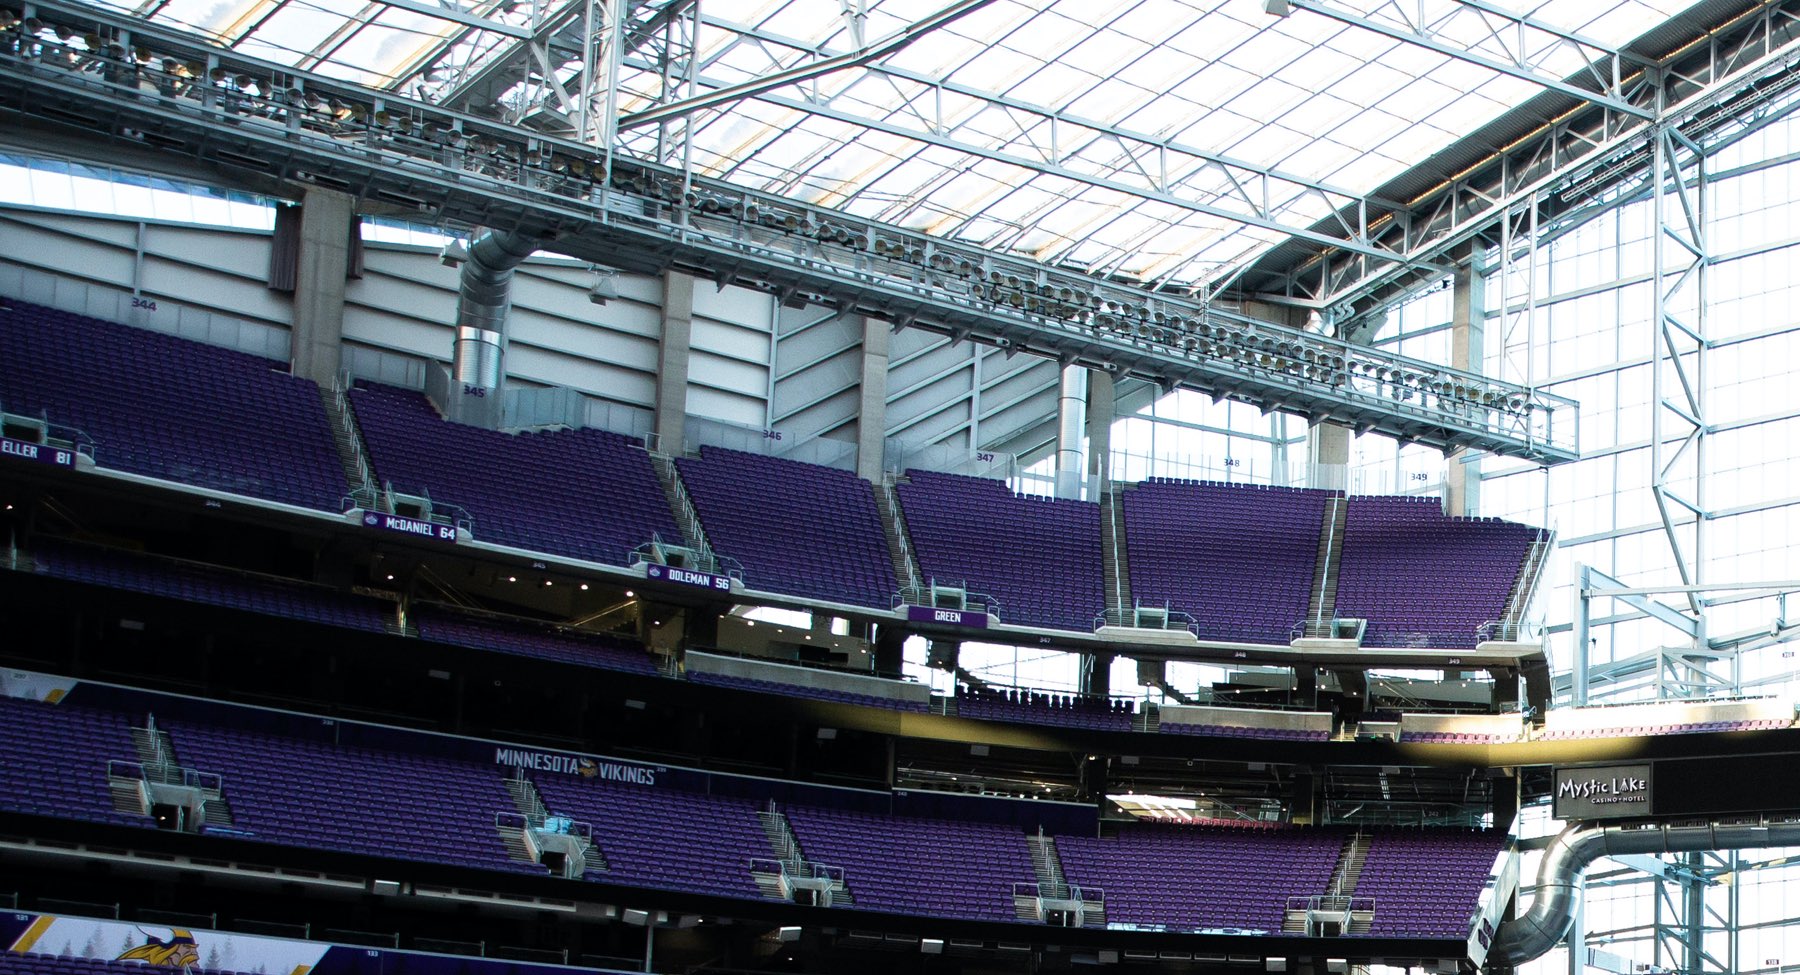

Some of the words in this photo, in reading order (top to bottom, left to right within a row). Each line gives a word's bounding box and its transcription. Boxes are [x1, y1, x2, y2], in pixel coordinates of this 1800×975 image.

[132, 297, 157, 312] 344
[464, 385, 485, 398] 345
[763, 429, 782, 441] 346
[55, 451, 72, 465] 81
[977, 453, 995, 463] 347
[1224, 458, 1240, 467] 348
[1411, 473, 1428, 482] 349
[386, 516, 434, 537] McDANIEL
[440, 526, 456, 541] 64
[669, 568, 710, 587] DOLEMAN
[715, 577, 730, 590] 56
[935, 610, 961, 623] GREEN
[496, 748, 580, 775] MINNESOTA
[600, 762, 655, 786] VIKINGS
